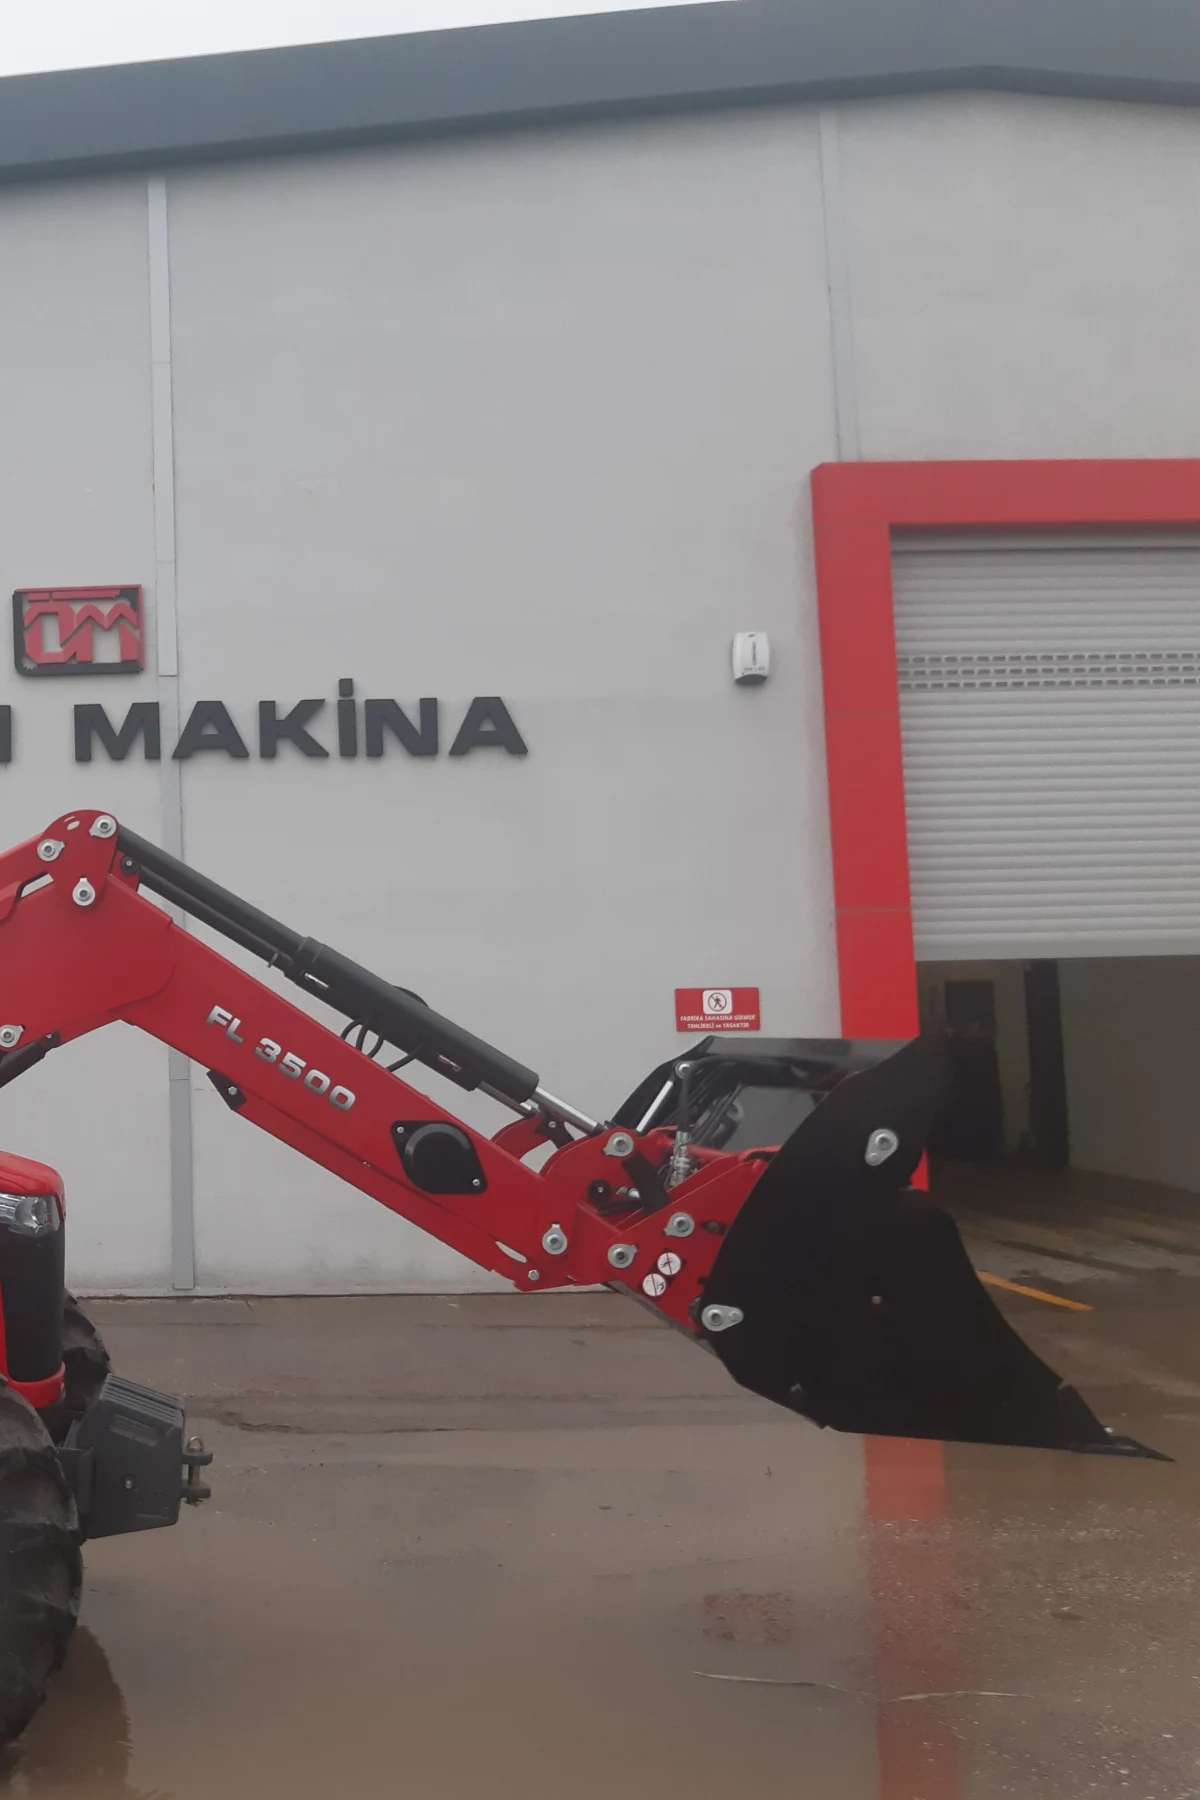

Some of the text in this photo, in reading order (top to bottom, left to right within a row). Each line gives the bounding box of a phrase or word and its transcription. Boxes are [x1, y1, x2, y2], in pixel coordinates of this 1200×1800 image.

[74, 678, 528, 760] MAKİNA
[206, 1005, 356, 1112] FL 3500
